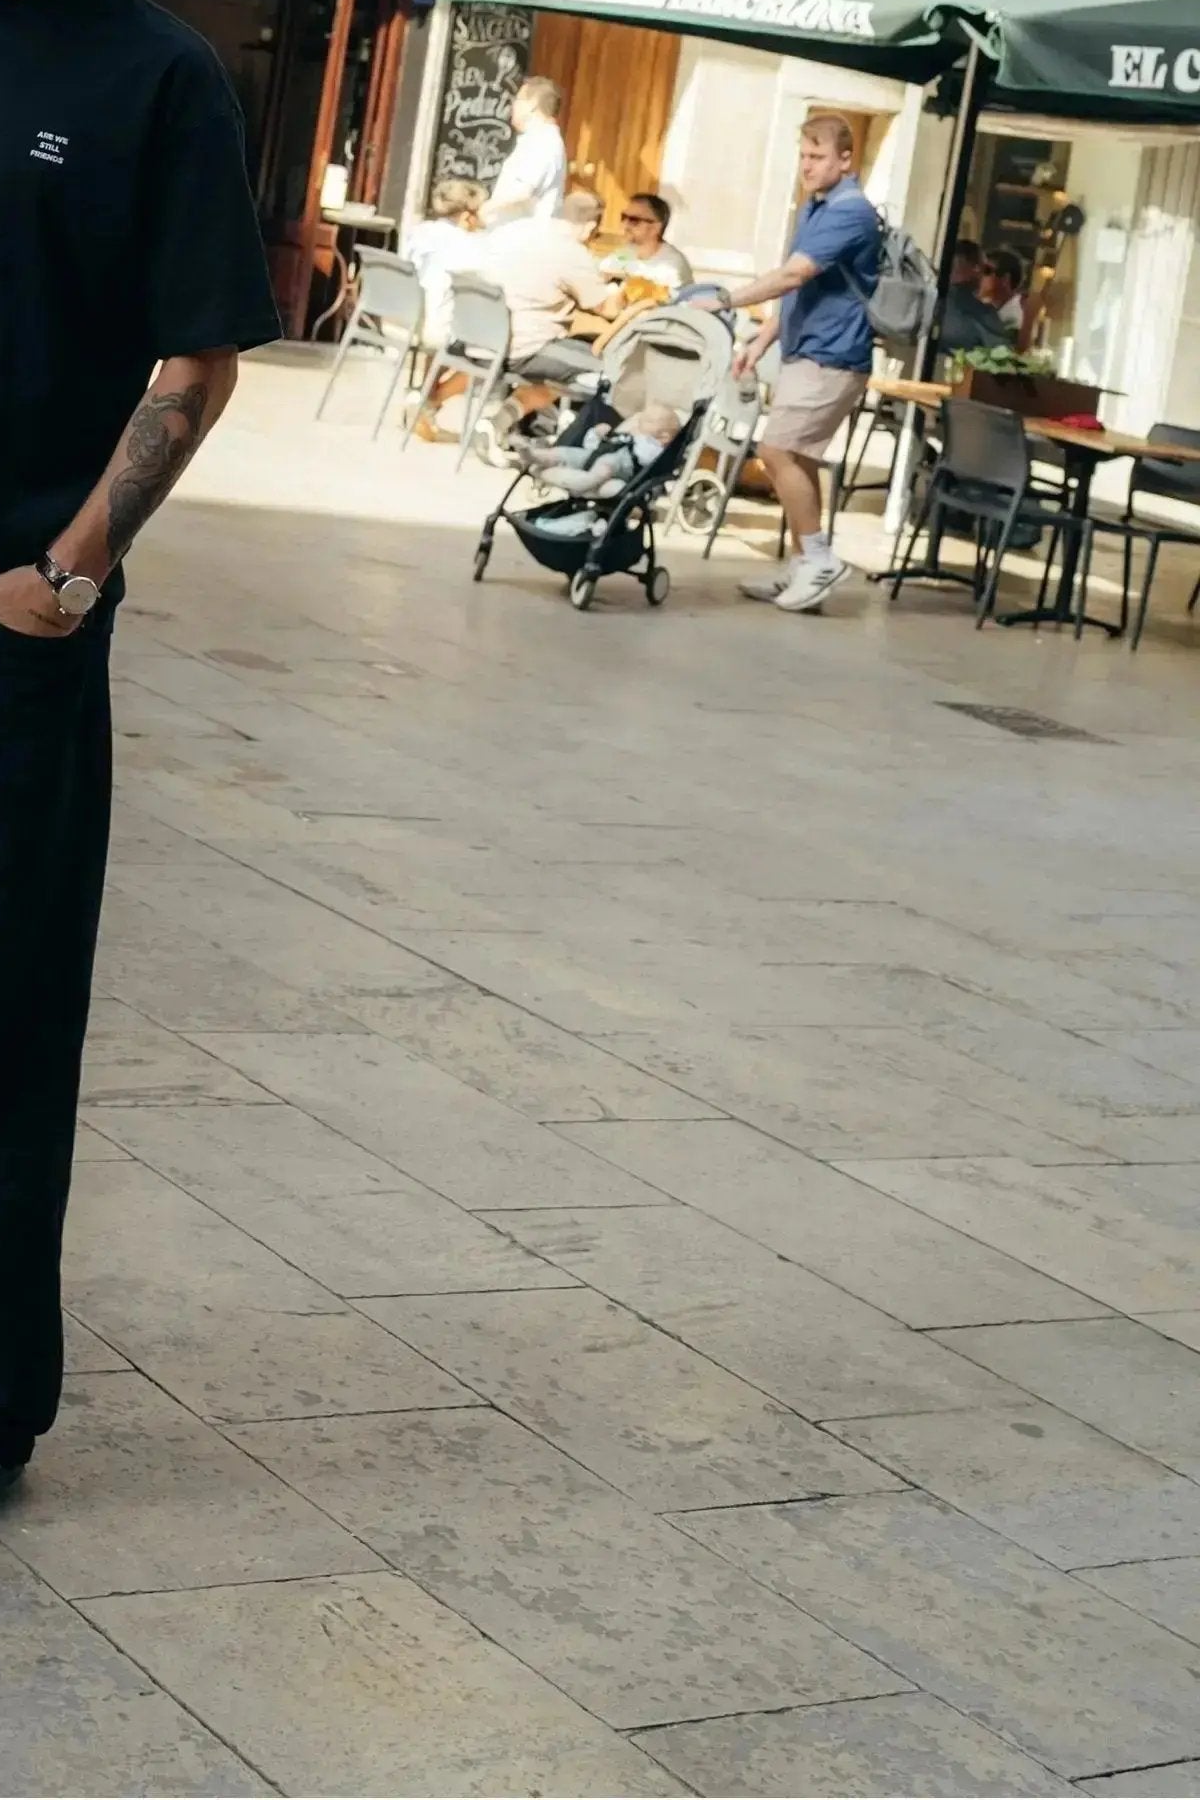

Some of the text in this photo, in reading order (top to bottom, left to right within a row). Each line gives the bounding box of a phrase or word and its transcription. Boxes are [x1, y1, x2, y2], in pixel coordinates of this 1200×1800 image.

[1107, 44, 1169, 90] EL
[36, 131, 69, 145] ARE WE
[39, 141, 60, 153] STILL
[29, 149, 64, 164] FRIENDS
